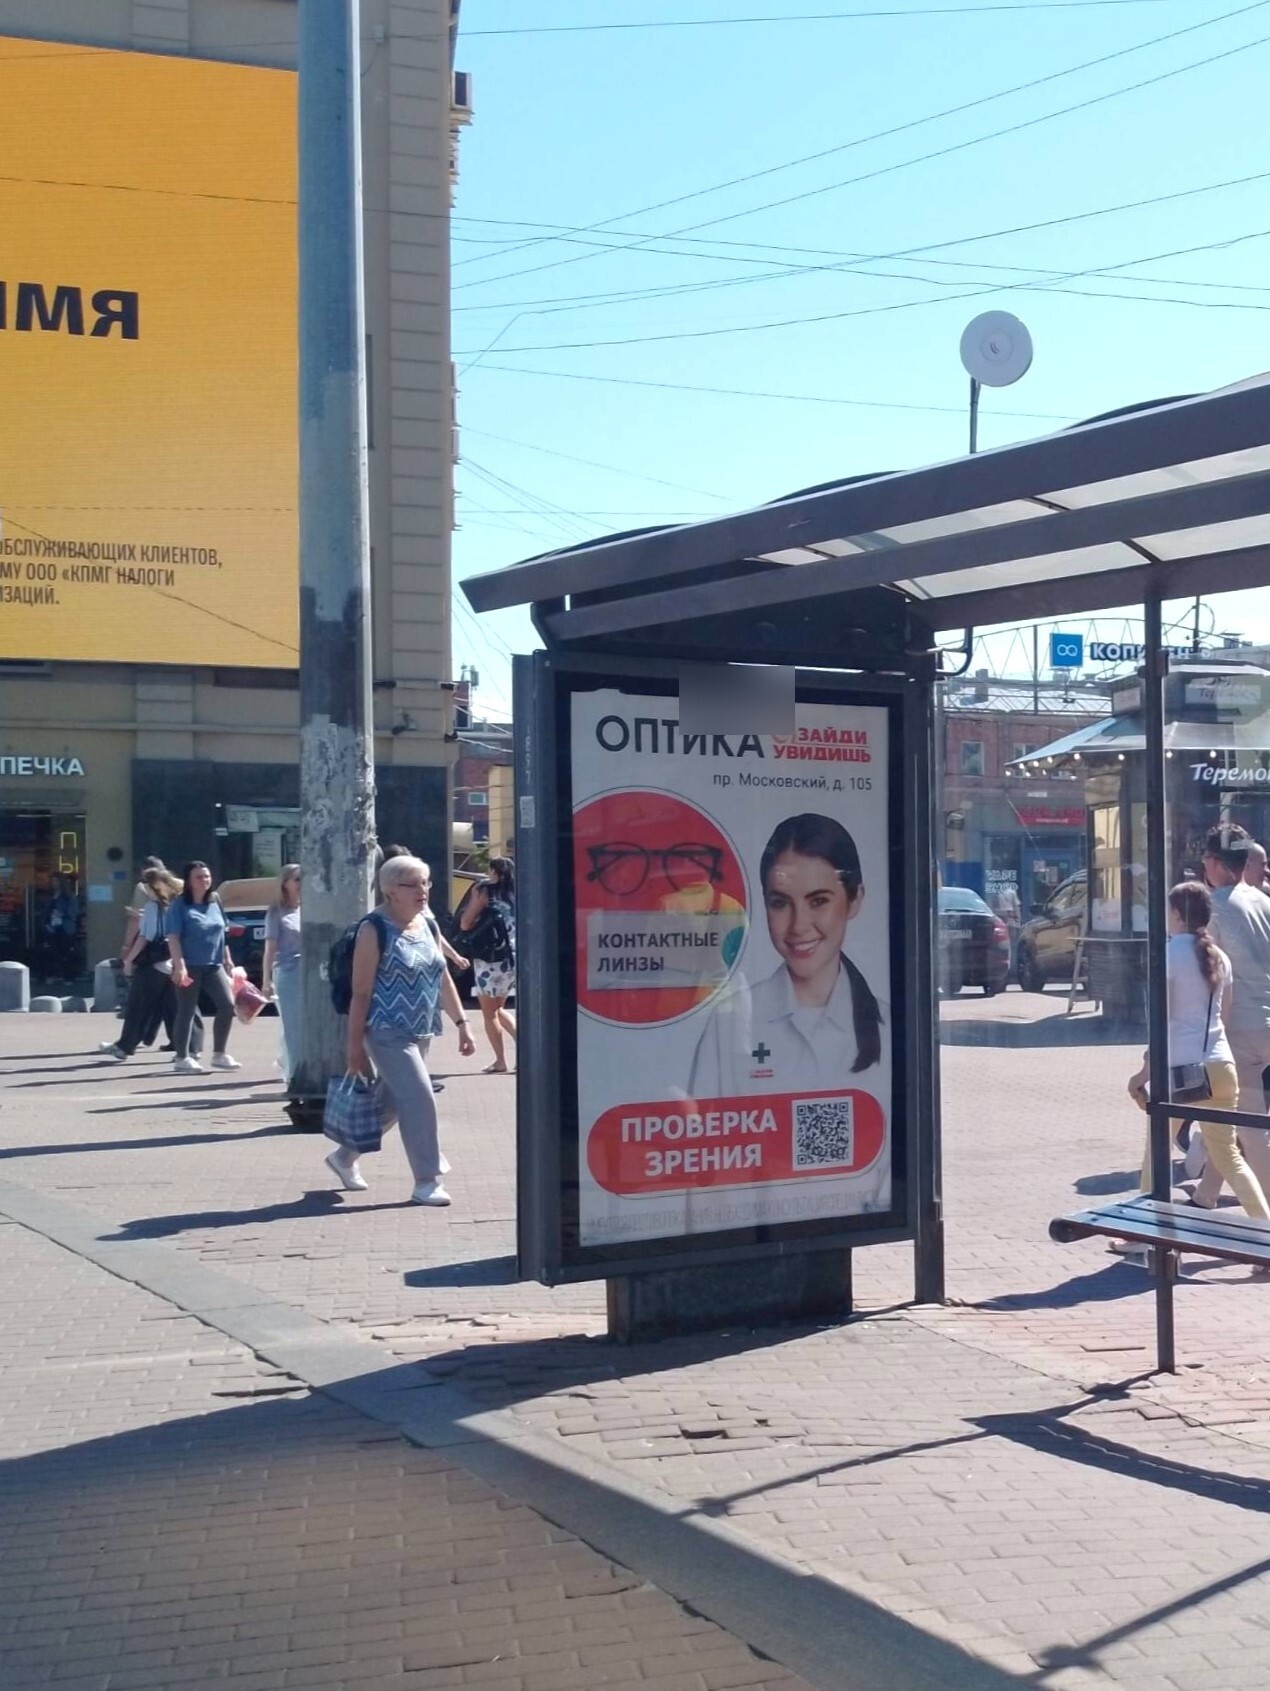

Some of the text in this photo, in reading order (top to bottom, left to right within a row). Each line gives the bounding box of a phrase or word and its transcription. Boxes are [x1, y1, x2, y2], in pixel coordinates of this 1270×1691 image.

[0, 281, 139, 340] МЯ
[140, 545, 223, 569] КЛИЕНТОВ,
[62, 565, 112, 584] «КПМГ
[117, 566, 175, 587] НАЛОГИ
[0, 585, 60, 607] ЗАЦИЙ.
[798, 726, 868, 746] ЗАЙДИ
[772, 745, 873, 763] УВИДИШЬ
[0, 756, 85, 776] ПЕЧКА
[713, 773, 873, 792] пр. Московский, д. 105
[598, 932, 720, 949] КОНТАКТНЫЕ
[597, 956, 665, 973] ЛИНЗЫ
[621, 1108, 778, 1143] ПРОВЕРКА
[644, 1143, 762, 1177] ЗРЕНИЯ
